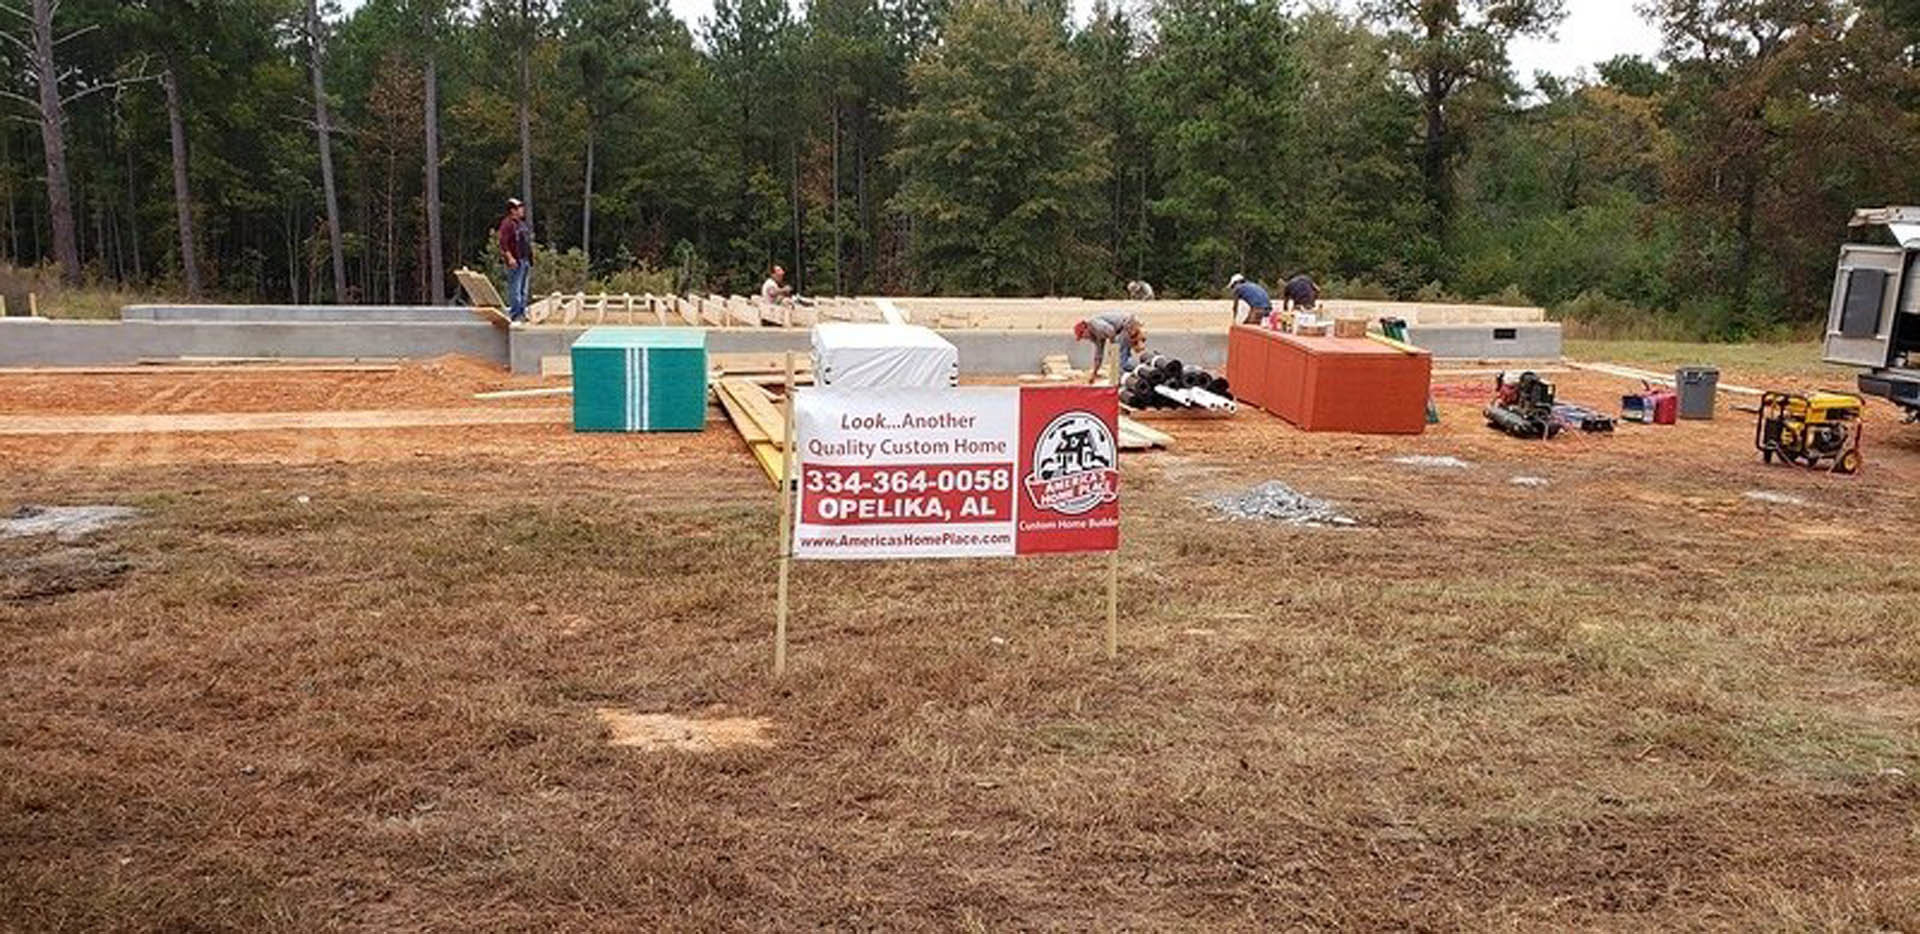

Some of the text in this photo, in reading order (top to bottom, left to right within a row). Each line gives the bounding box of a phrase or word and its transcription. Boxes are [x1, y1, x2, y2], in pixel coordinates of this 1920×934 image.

[841, 412, 976, 430] Look...Another
[809, 437, 1007, 459] Quality Custom Home
[806, 470, 1009, 494] 334-364-0058
[1041, 480, 1112, 505] HOME PLACE
[818, 496, 996, 521] OPELIKA, AL
[1019, 520, 1057, 532] Custom
[1058, 518, 1087, 530] Home
[801, 532, 1011, 548] www.AmericasHomePlace.com
